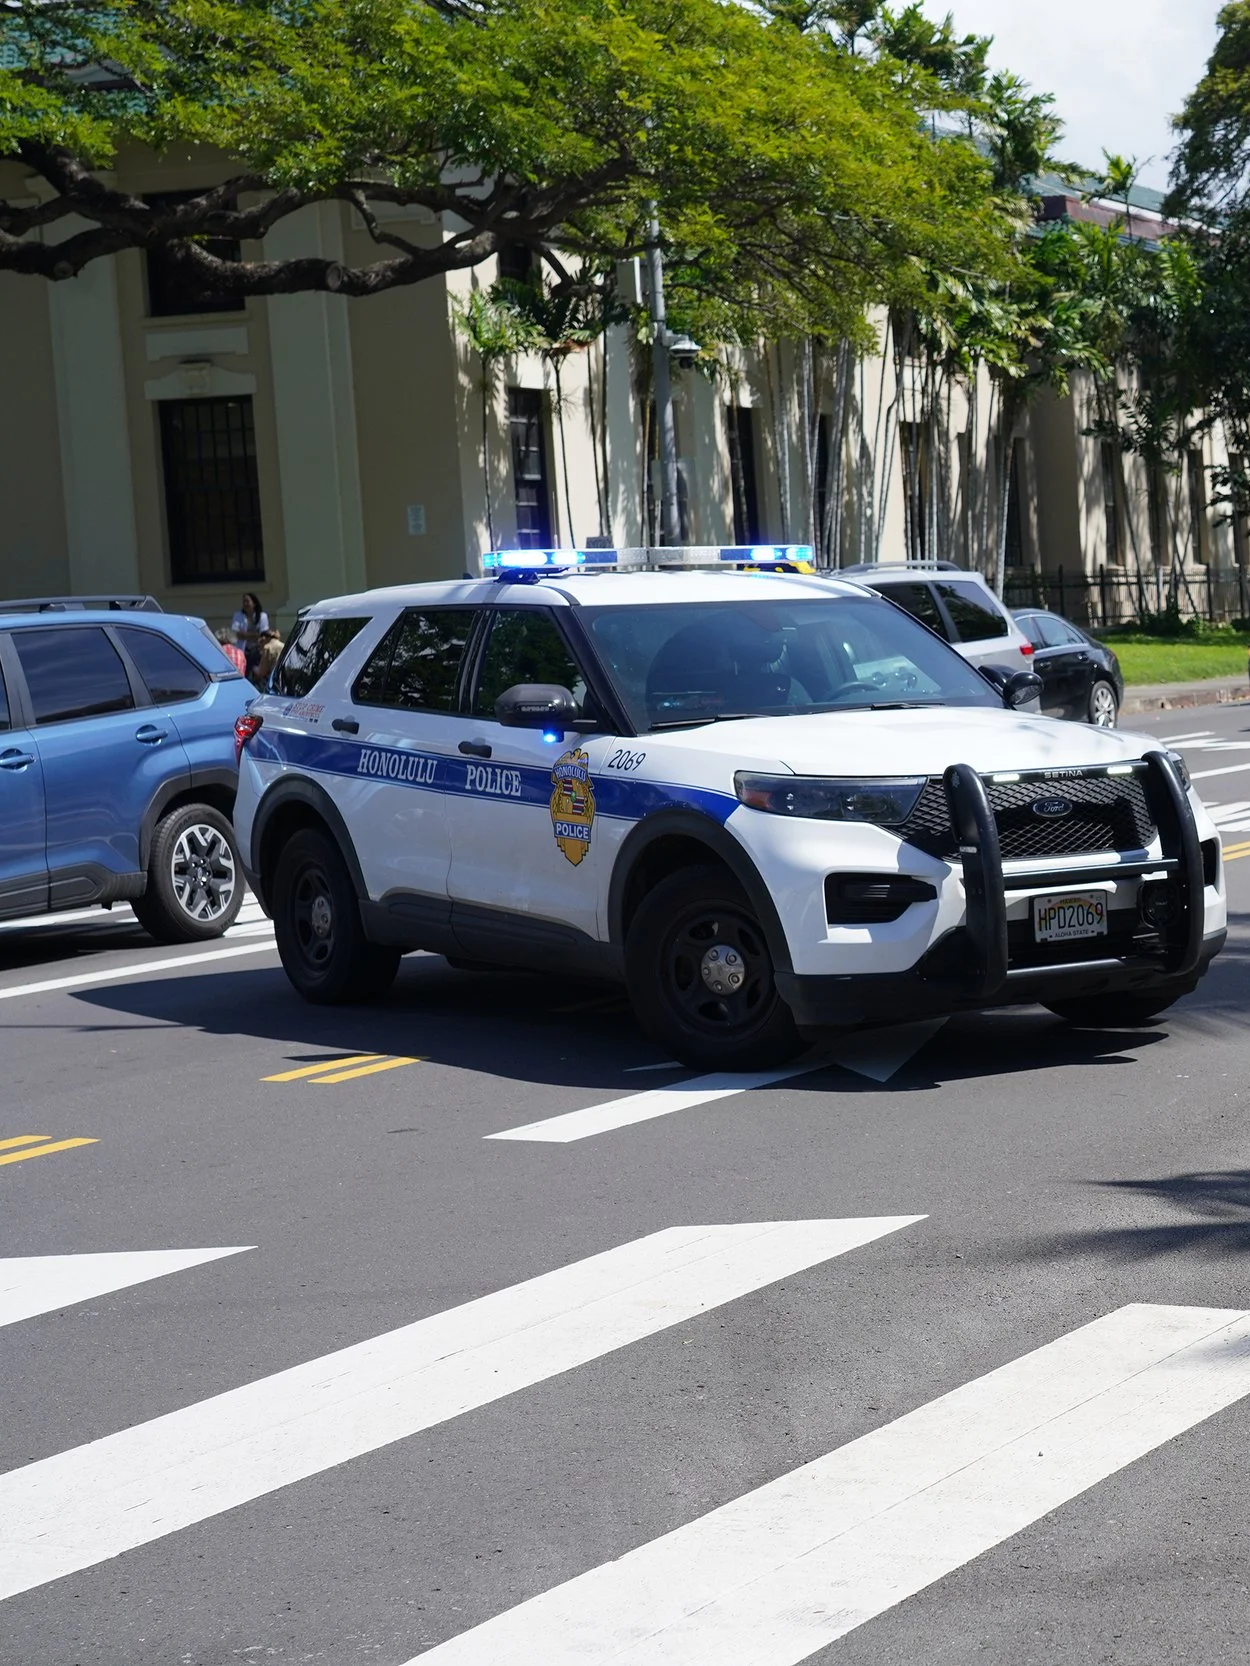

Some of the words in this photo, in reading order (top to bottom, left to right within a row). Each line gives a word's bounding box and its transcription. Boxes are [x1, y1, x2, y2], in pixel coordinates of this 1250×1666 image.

[607, 749, 647, 771] 2069
[357, 749, 438, 784] HONOLULU
[465, 764, 522, 797] POLICE
[554, 764, 587, 782] HONOLULU
[1044, 770, 1083, 779] SETINA
[1044, 801, 1065, 812] Ford
[556, 823, 589, 839] POLICE
[1038, 902, 1104, 931] HPD2069
